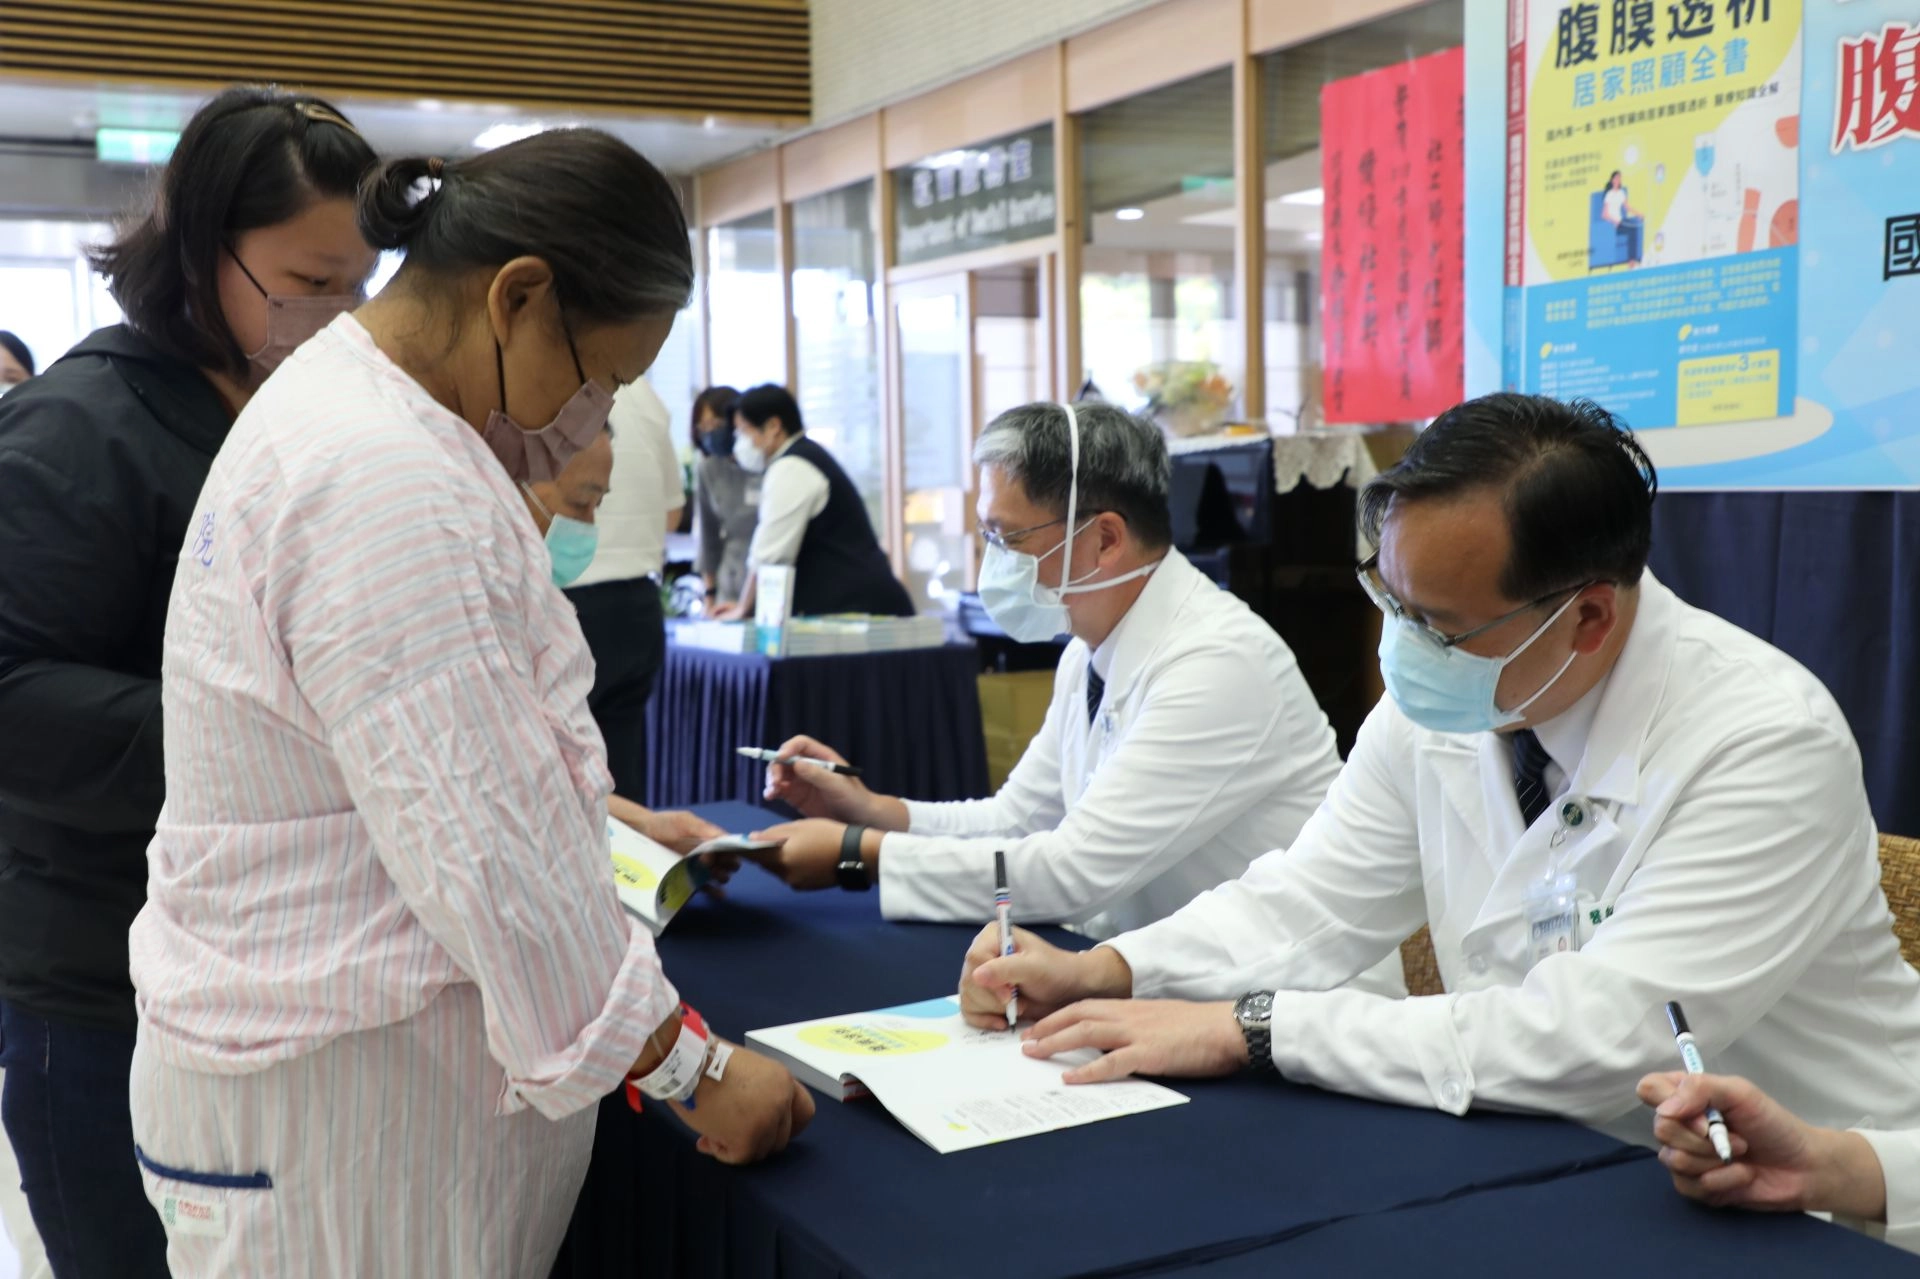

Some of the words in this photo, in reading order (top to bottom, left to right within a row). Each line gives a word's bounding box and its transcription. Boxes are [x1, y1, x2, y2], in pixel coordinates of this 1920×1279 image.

[1572, 37, 1750, 109] 居家照顧全書
[1832, 24, 1920, 153] 腹
[1883, 212, 1920, 282] 國
